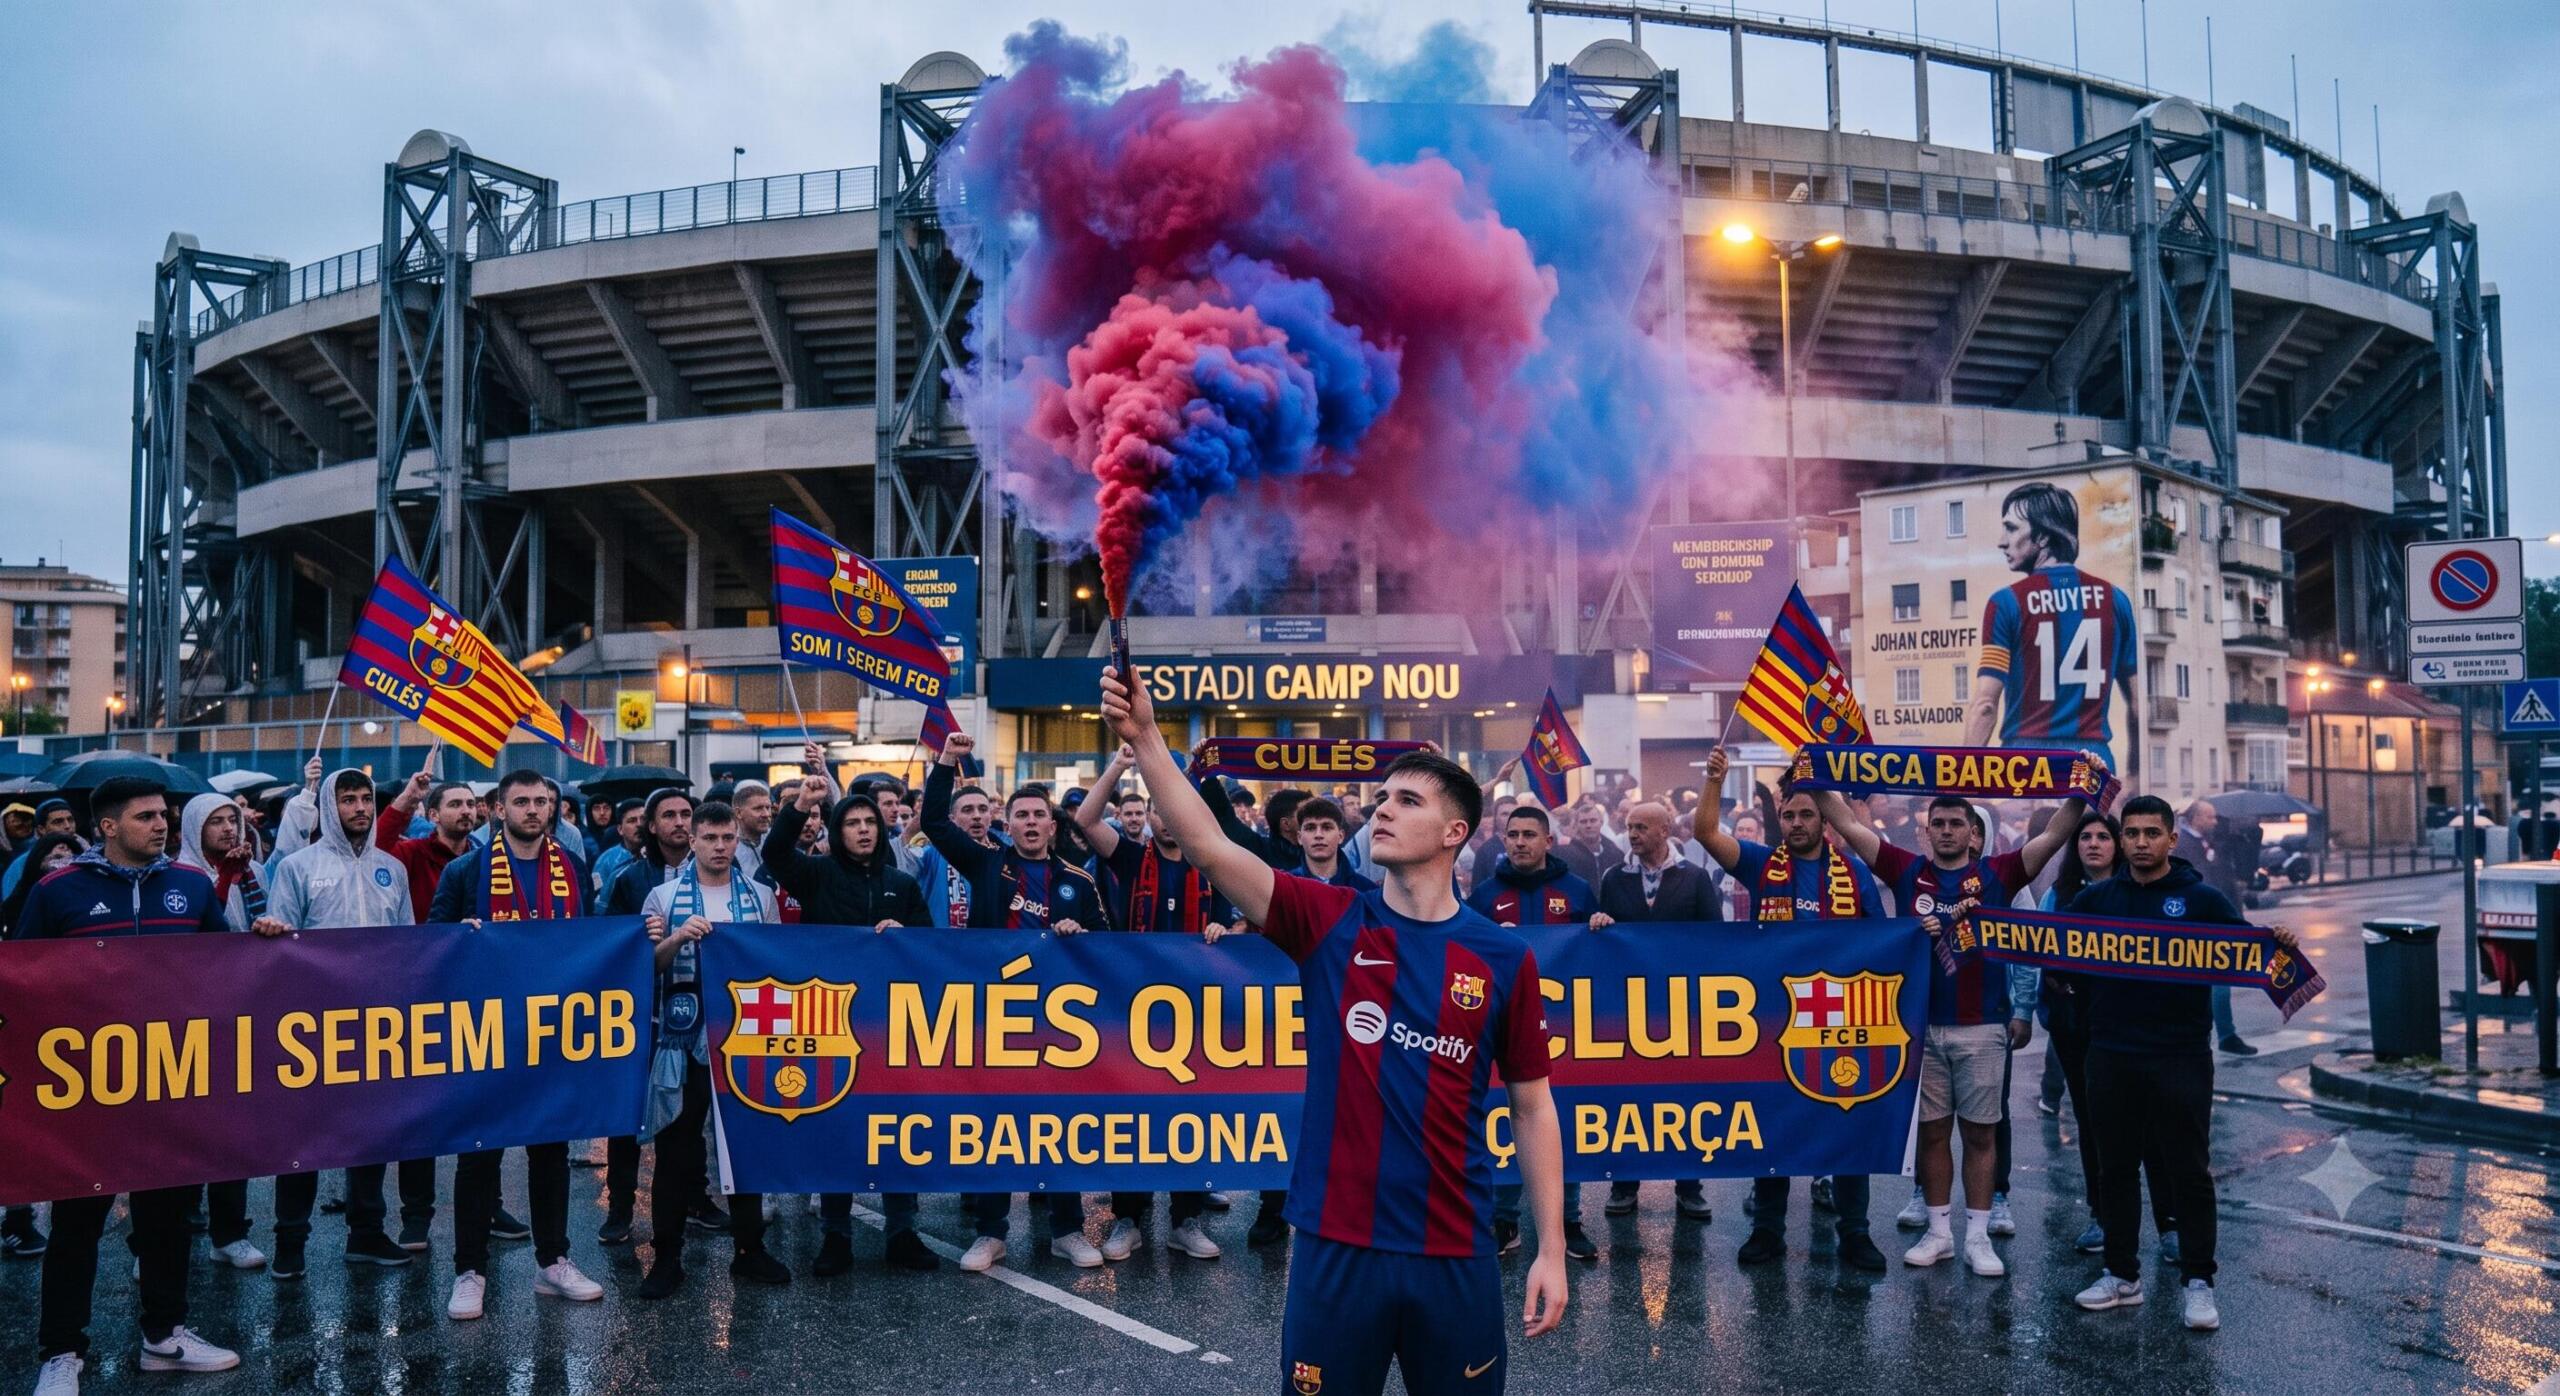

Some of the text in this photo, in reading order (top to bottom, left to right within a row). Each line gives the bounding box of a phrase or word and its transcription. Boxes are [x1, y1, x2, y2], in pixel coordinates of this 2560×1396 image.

[2027, 585, 2105, 615] CRUYFF
[1871, 628, 1978, 652] JOHAN CRUYFF
[2034, 618, 2106, 701] 14
[791, 632, 940, 698] SOM I SEREM FCB
[1265, 664, 1374, 701] CAMP
[1383, 663, 1460, 700] NOU
[364, 667, 424, 710] CULÉS
[1874, 706, 1964, 726] EL SALVADOR
[1254, 739, 1377, 772] CULÉS
[1826, 750, 2054, 797] VISCA BARÇA
[1980, 920, 2263, 972] PENYA BARCELONISTA
[887, 953, 1101, 1069] MÉS
[1128, 982, 1308, 1084] QUE
[1821, 1029, 1870, 1045] FCB
[36, 989, 637, 1111] SOM I SEREM FCB
[766, 1037, 817, 1054] FCB
[1390, 1022, 1474, 1064] Spotify
[867, 1112, 1289, 1166] FC BARCELONA
[1575, 1101, 1764, 1163] BARÇA
